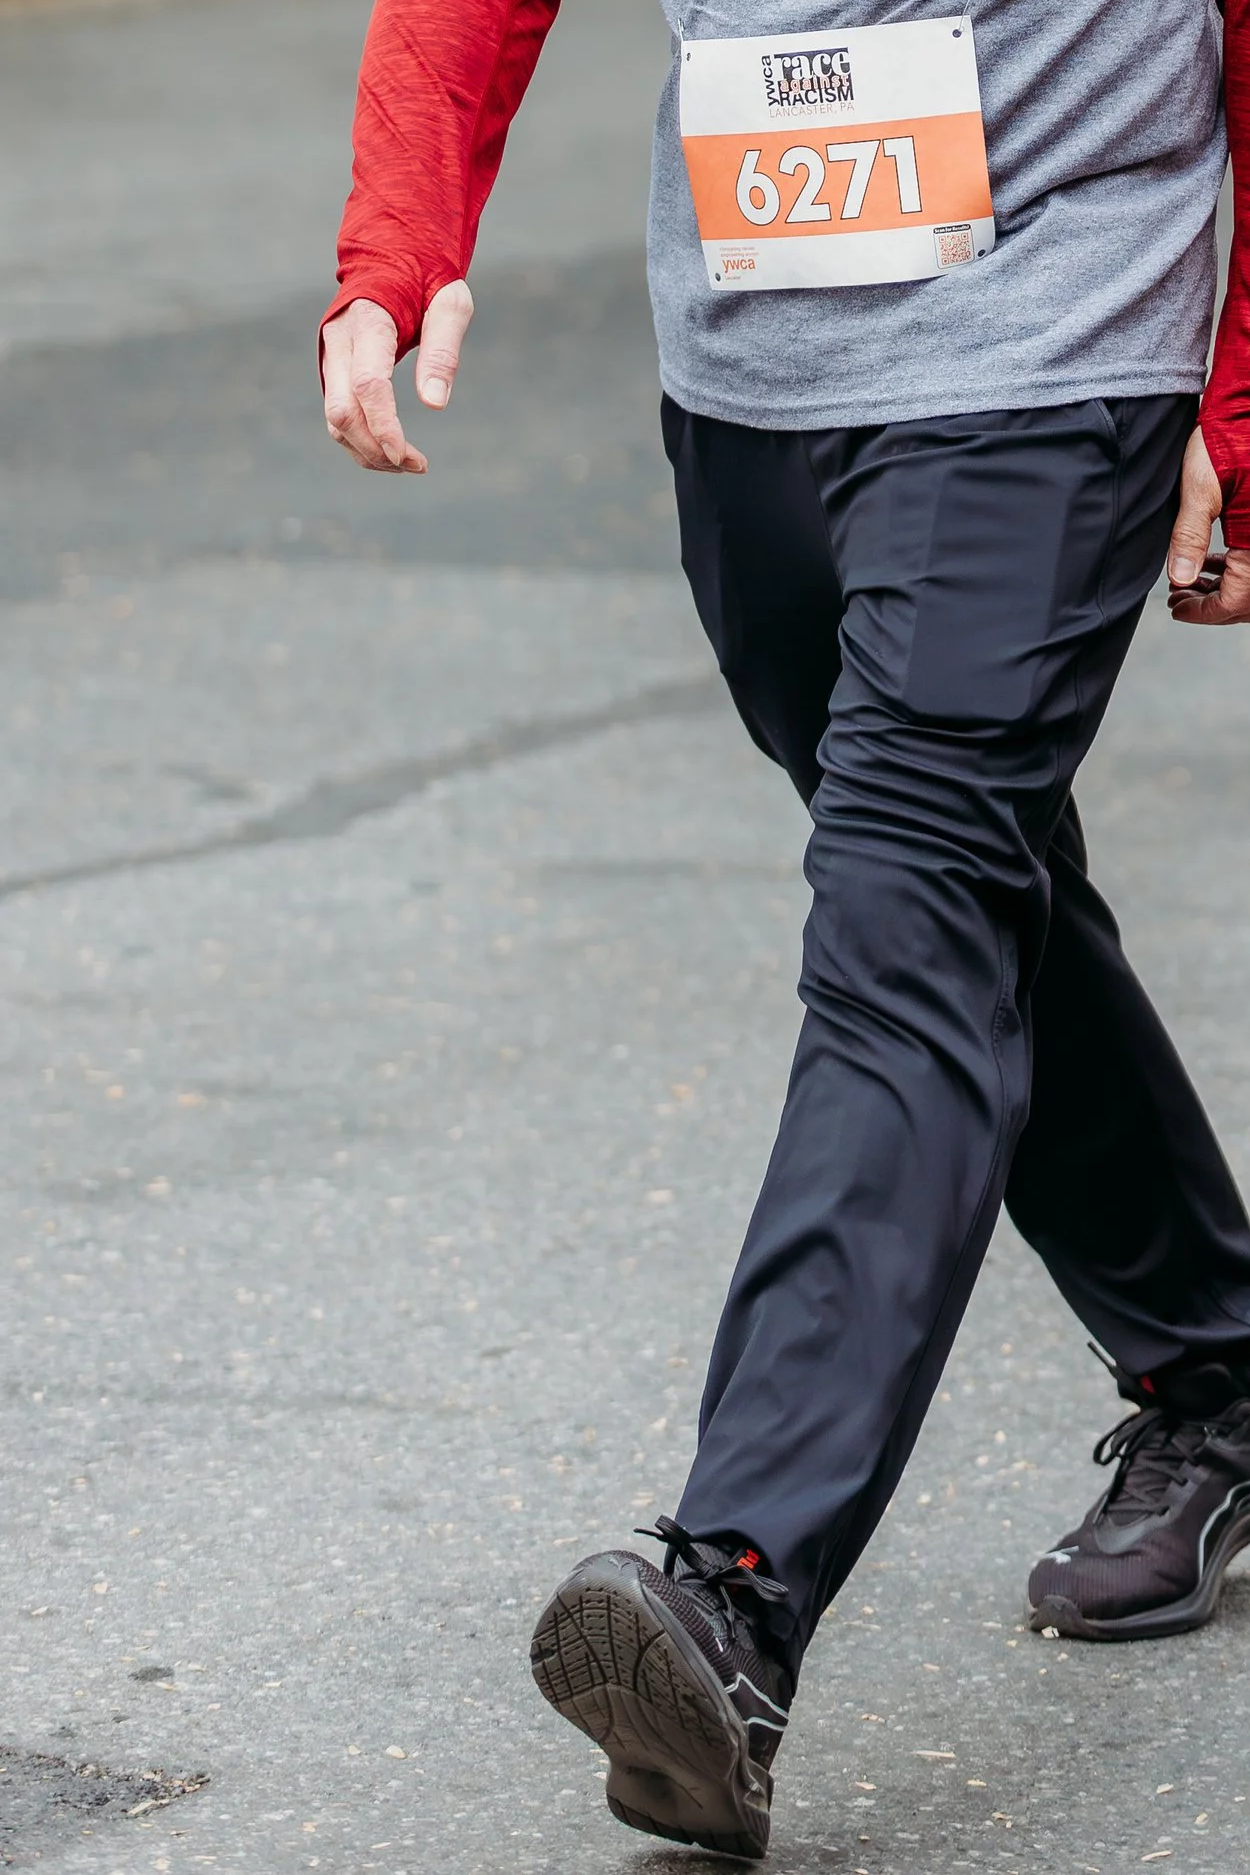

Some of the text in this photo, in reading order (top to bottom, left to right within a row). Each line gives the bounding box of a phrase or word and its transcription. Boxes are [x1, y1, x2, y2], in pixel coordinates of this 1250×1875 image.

[774, 52, 851, 80] race
[761, 55, 780, 107] ywca
[780, 74, 850, 94] against
[780, 86, 854, 107] RACISM
[769, 102, 855, 118] LANCASTER, PA
[735, 136, 922, 226] 6271
[722, 258, 756, 274] ywca
